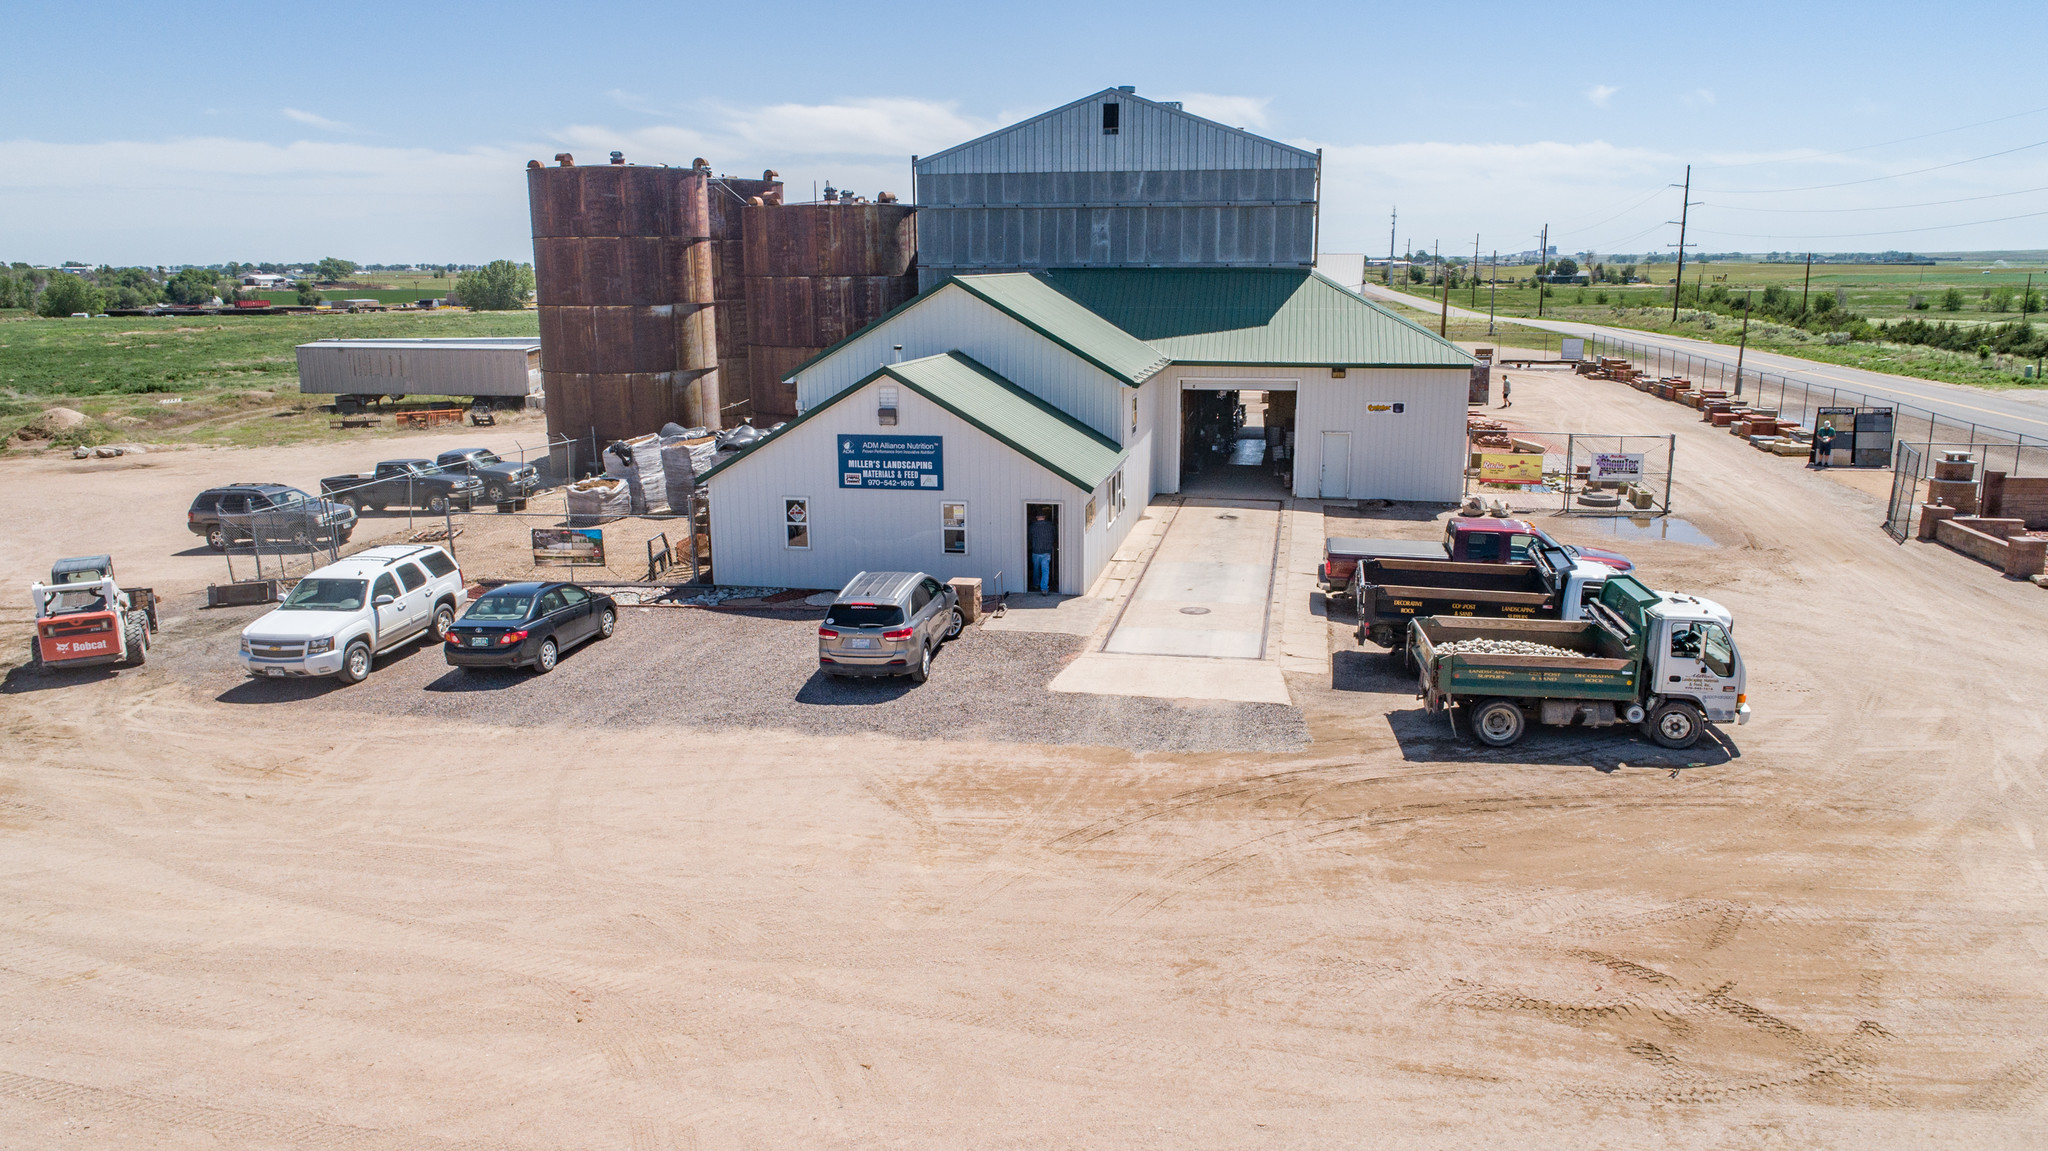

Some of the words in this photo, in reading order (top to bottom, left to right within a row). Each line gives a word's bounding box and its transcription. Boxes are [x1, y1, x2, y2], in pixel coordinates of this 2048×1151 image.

[848, 460, 880, 468] MILLER'S
[883, 460, 933, 469] LANDSCAPING
[1483, 460, 1506, 470] Ritchie
[862, 470, 895, 478] MATERIALS
[72, 640, 107, 652] Bobcat
